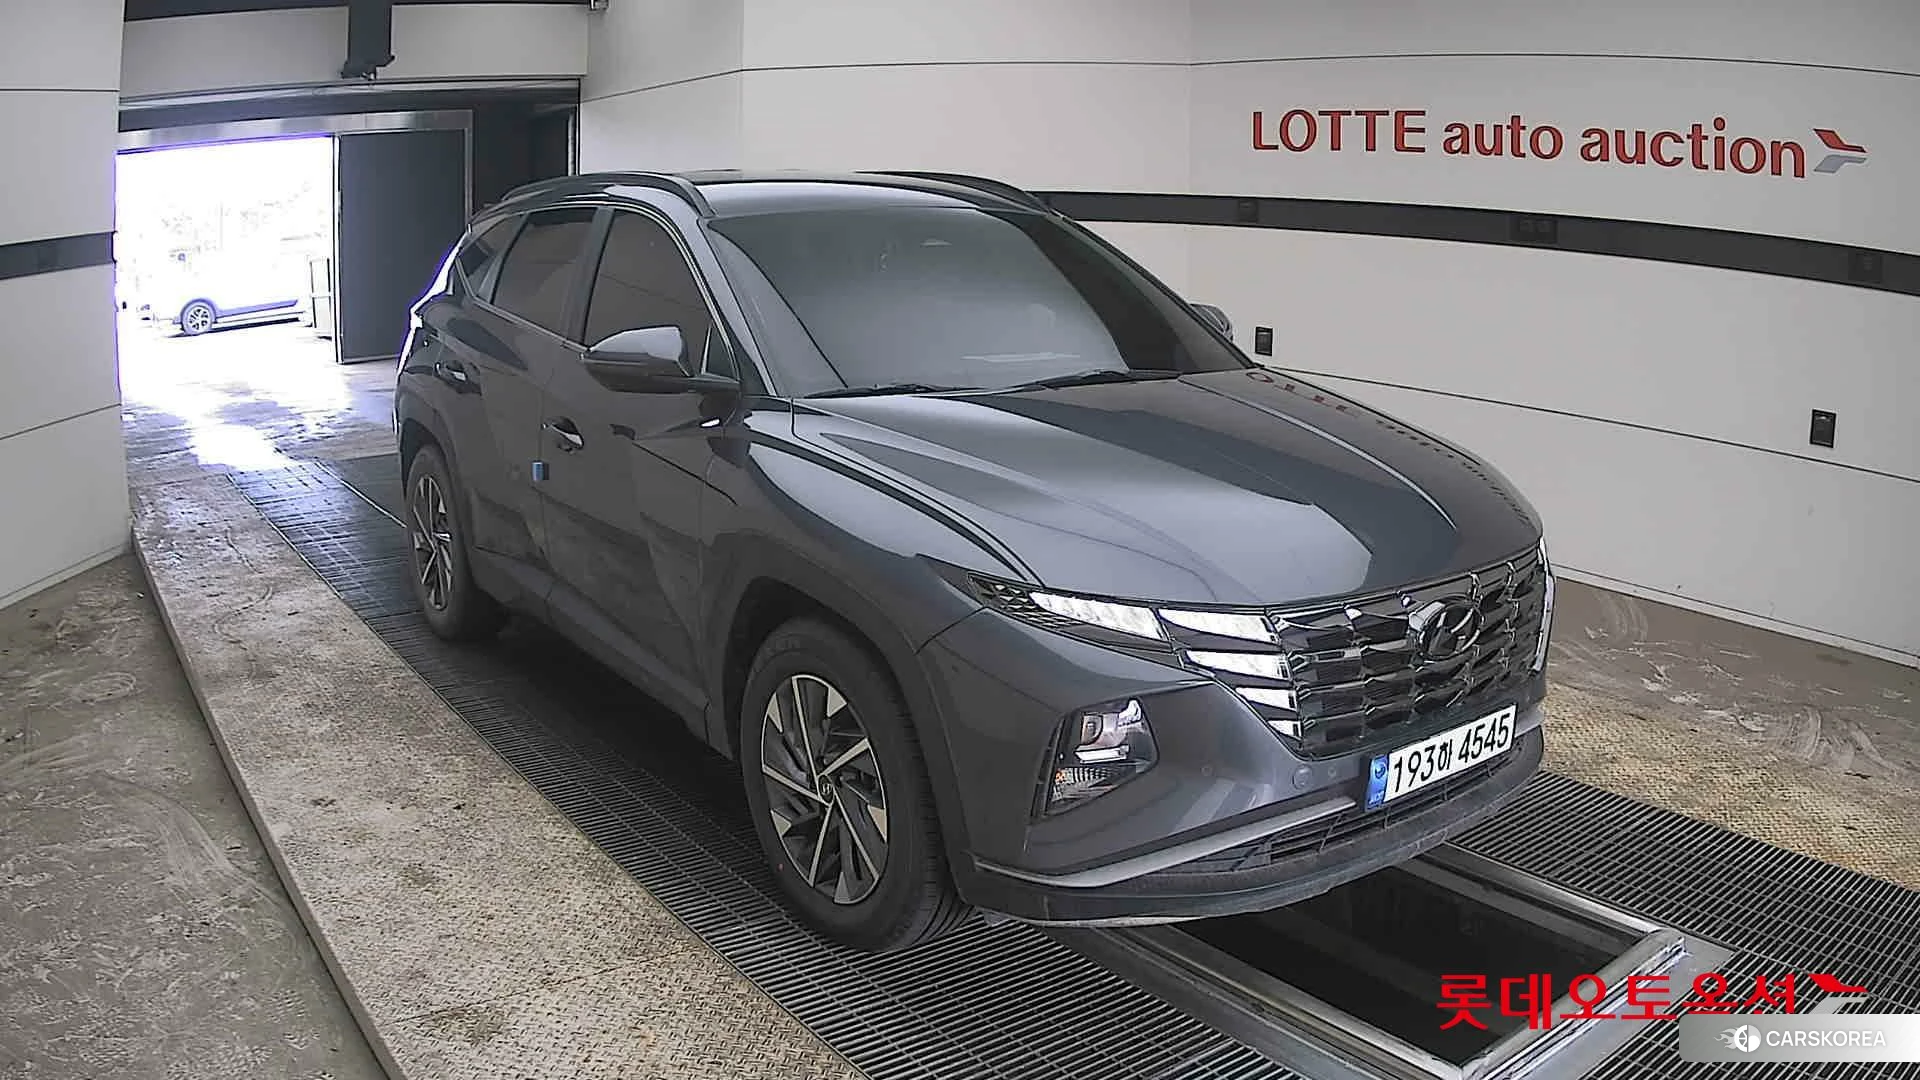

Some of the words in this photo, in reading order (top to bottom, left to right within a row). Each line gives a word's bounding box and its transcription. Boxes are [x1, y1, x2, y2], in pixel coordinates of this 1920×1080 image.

[1252, 109, 1426, 153] LOTTE
[1442, 115, 1564, 160] auto
[1580, 116, 1806, 179] auction
[1393, 739, 1453, 792] 193하
[1458, 713, 1511, 763] 4545
